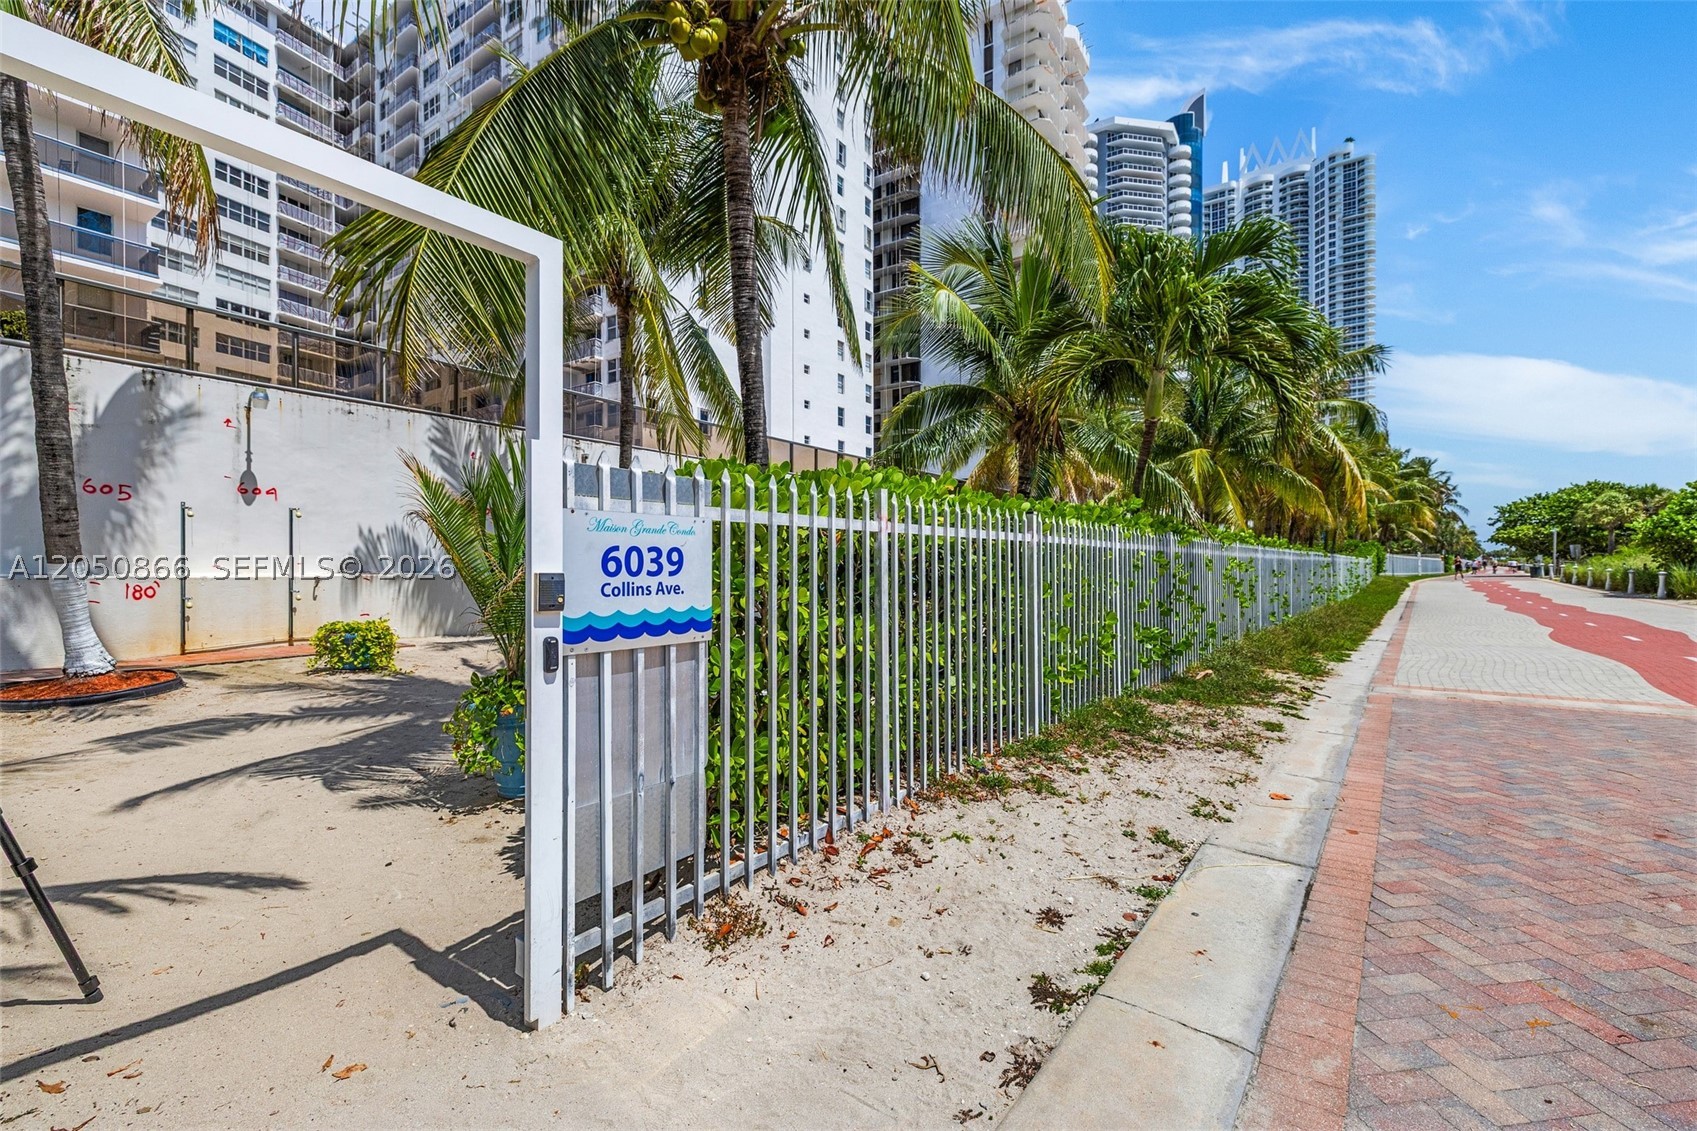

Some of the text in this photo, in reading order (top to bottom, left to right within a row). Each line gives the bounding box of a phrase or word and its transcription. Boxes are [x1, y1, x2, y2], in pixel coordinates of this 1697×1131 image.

[82, 478, 133, 501] 605
[587, 517, 696, 537] Maison Grande Condo
[601, 545, 684, 578] 6039
[600, 581, 685, 598] Collins Ave.
